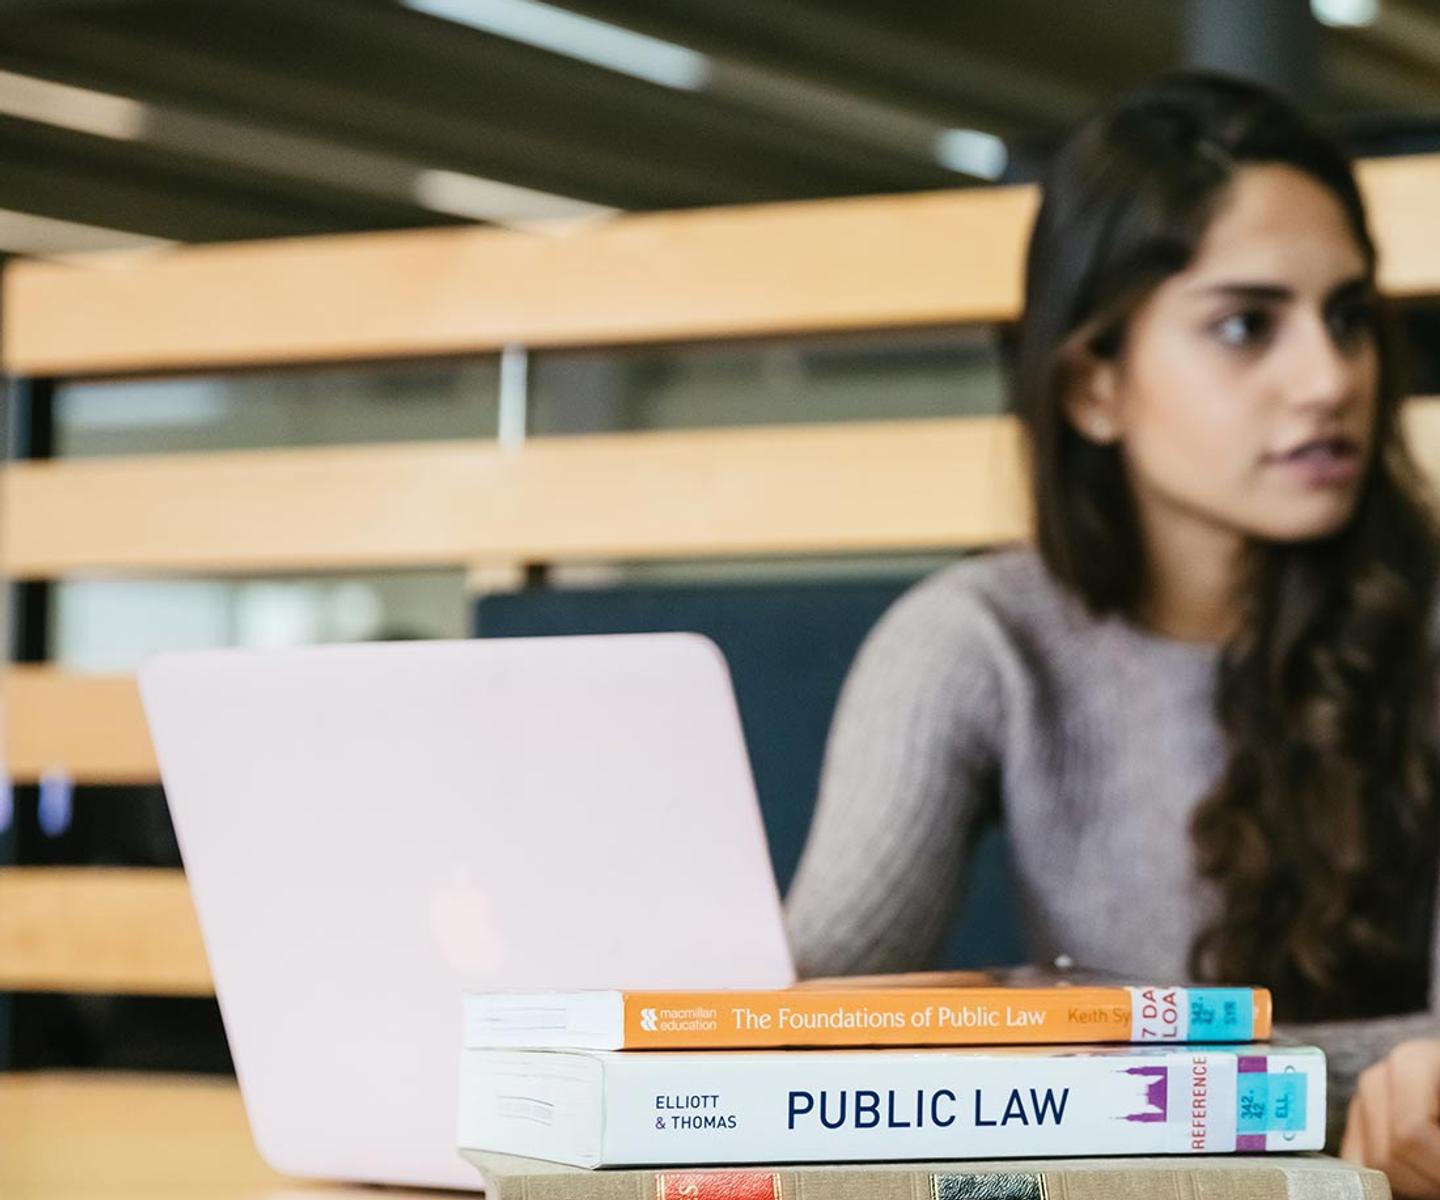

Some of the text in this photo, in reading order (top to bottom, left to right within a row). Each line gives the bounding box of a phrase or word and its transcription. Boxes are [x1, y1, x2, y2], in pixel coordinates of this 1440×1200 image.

[660, 1008, 717, 1019] macmillan
[732, 1006, 1046, 1030] The Foundations of Public Law
[1067, 1007, 1132, 1029] Keith Sy
[1142, 989, 1158, 1038] 7 DA
[1162, 991, 1178, 1038] LOA
[660, 1020, 717, 1031] education
[655, 1095, 720, 1110] ELLIOTT
[787, 1087, 1070, 1130] PUBLIC LAW
[1192, 1056, 1207, 1149] REFERENCE
[1250, 1102, 1265, 1119] 42
[1276, 1093, 1289, 1118] ELL
[655, 1115, 737, 1130] & THOMAS
